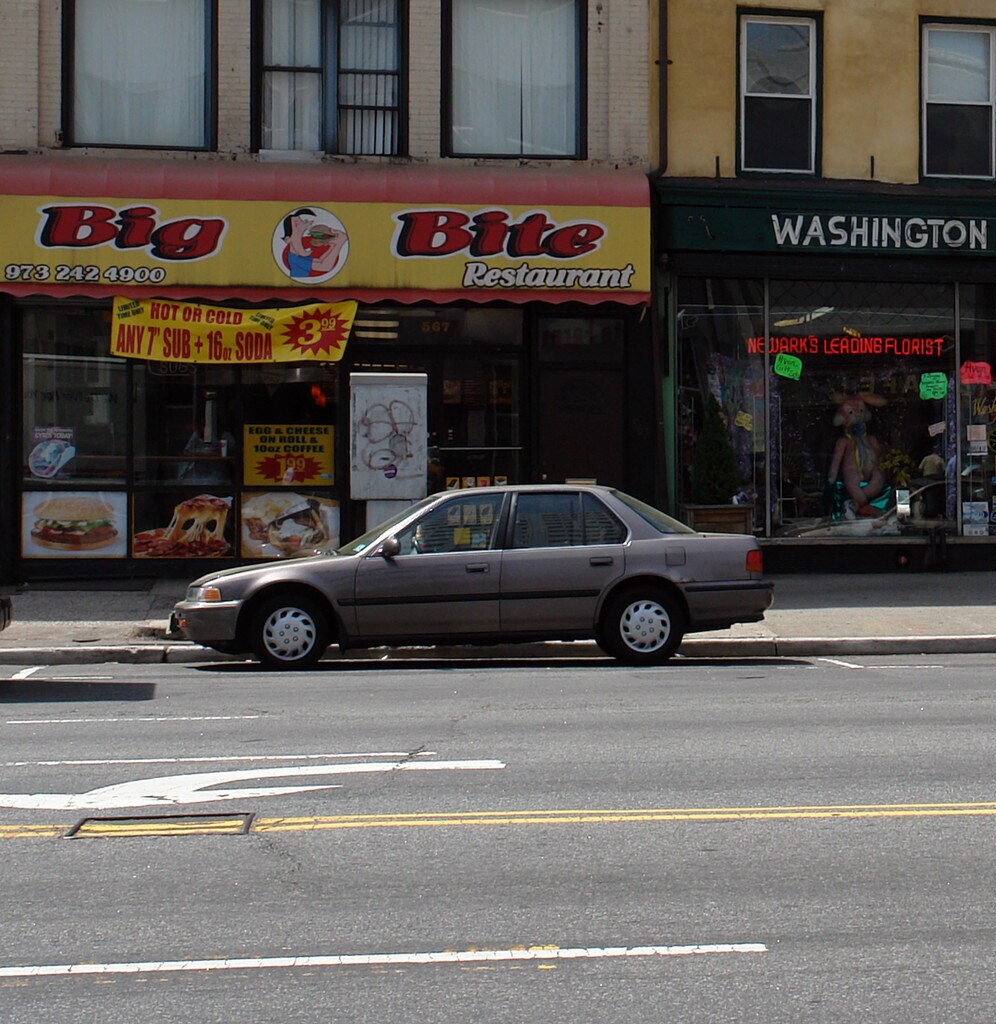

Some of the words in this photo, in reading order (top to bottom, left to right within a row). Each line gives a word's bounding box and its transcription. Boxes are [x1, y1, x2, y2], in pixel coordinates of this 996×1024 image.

[40, 205, 225, 262] Big
[396, 209, 606, 260] Bite
[771, 214, 987, 250] WASHINGTON
[4, 264, 50, 281] 973
[56, 265, 100, 282] 242
[104, 266, 166, 283] 4900
[462, 261, 635, 288] Restaurant
[151, 302, 180, 322] HOT
[183, 306, 201, 323] OR
[206, 308, 243, 326] COLD
[421, 320, 450, 333] 567
[117, 324, 145, 354] ANY
[148, 327, 160, 356] 7"
[164, 328, 191, 358] SUB
[207, 331, 232, 361] 16oz
[236, 332, 273, 360] SODA
[747, 336, 818, 355] NEWARK'S
[823, 337, 882, 355] LEADING
[885, 337, 945, 357] FLORIST
[249, 427, 271, 435] EGG
[286, 427, 329, 436] CHEESE
[260, 436, 276, 444] ON
[279, 436, 307, 444] ROLL
[254, 445, 280, 454] 10oz
[283, 445, 325, 454] COFFEE
